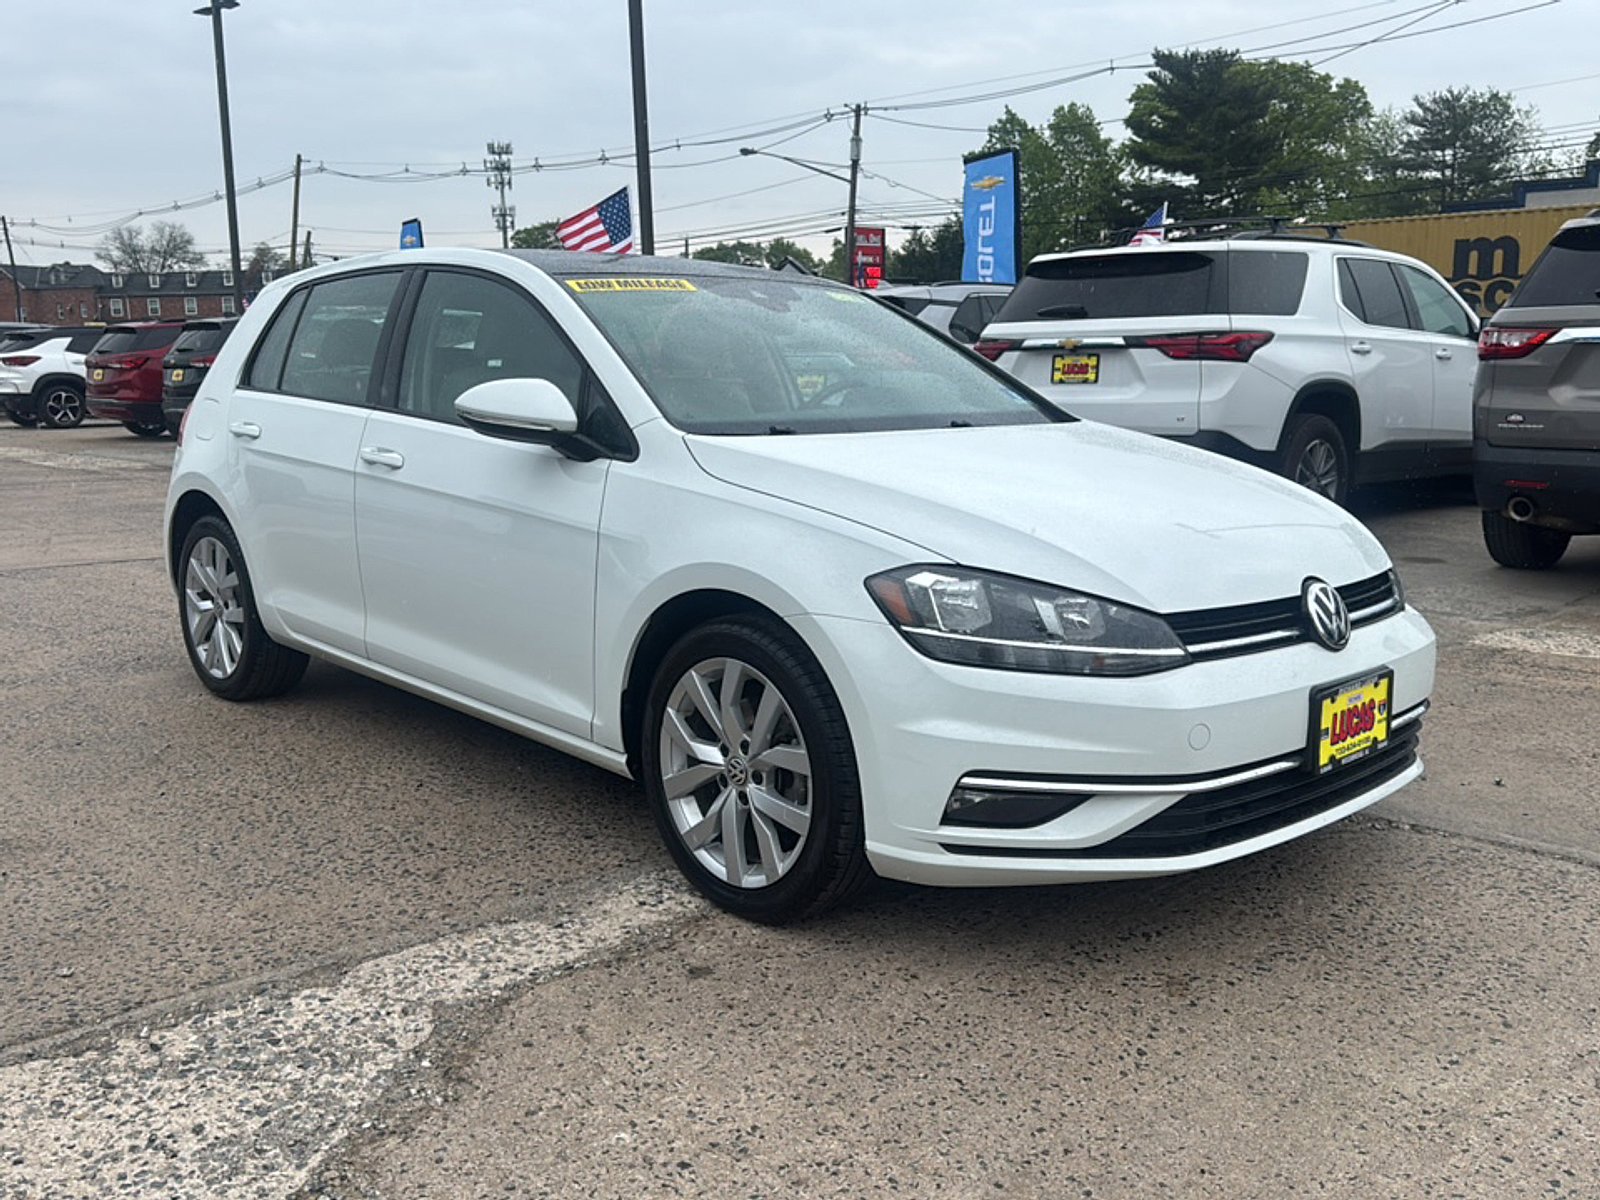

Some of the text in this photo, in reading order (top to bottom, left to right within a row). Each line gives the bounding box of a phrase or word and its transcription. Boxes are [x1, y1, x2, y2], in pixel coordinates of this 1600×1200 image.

[575, 280, 687, 290] LOW MILEAGE
[1062, 363, 1089, 375] LUCAS
[1330, 698, 1376, 746] LUCAS
